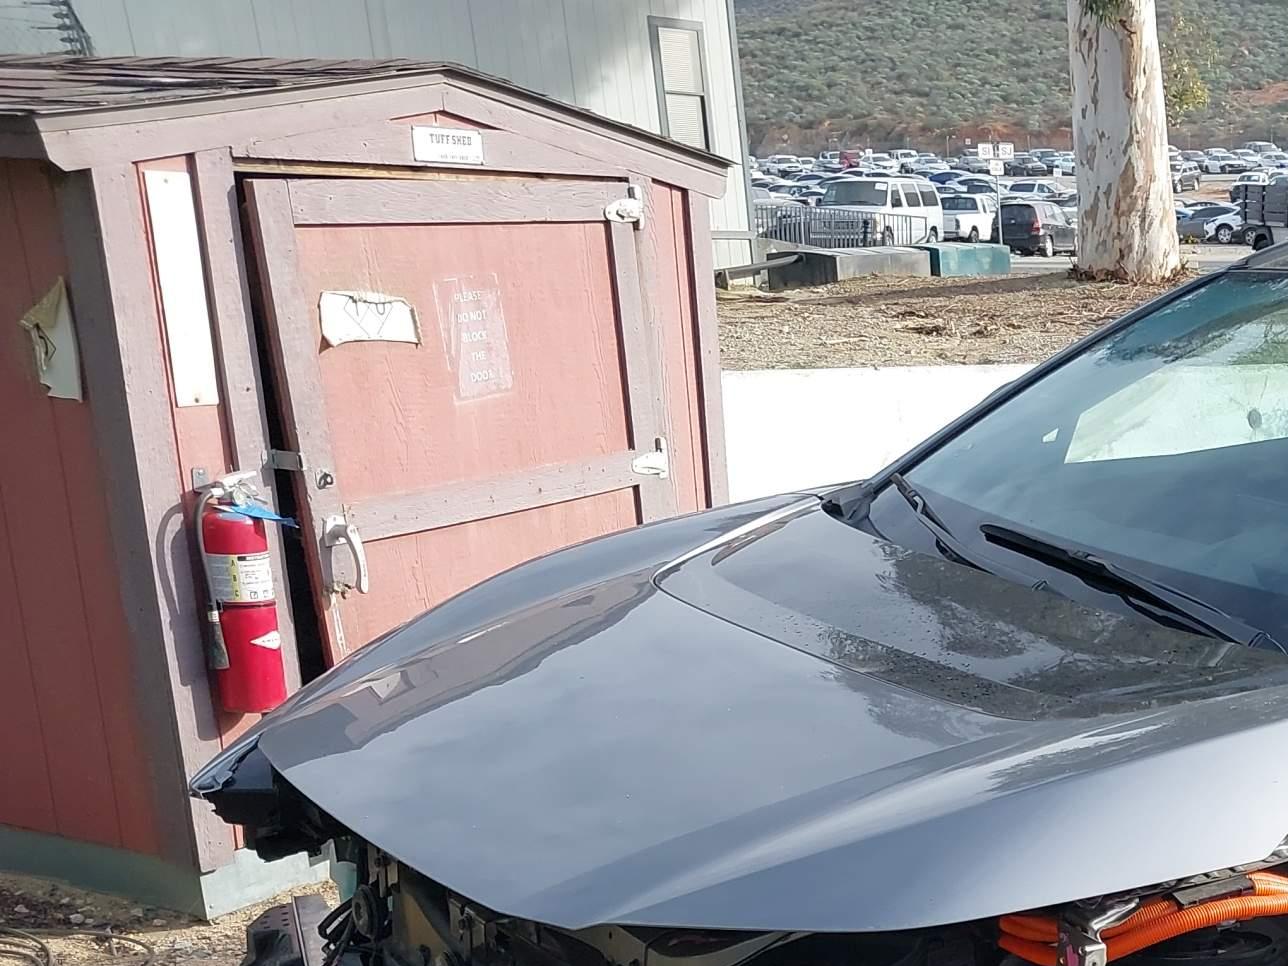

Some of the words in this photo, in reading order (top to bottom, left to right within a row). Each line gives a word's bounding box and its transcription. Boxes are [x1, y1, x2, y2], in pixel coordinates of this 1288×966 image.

[429, 133, 450, 144] TUFF
[451, 135, 472, 146] SHED
[454, 291, 481, 302] PLEASE
[457, 312, 469, 323] DO
[469, 309, 487, 320] NOT
[462, 330, 487, 343] BLOCK
[472, 351, 487, 361] THE
